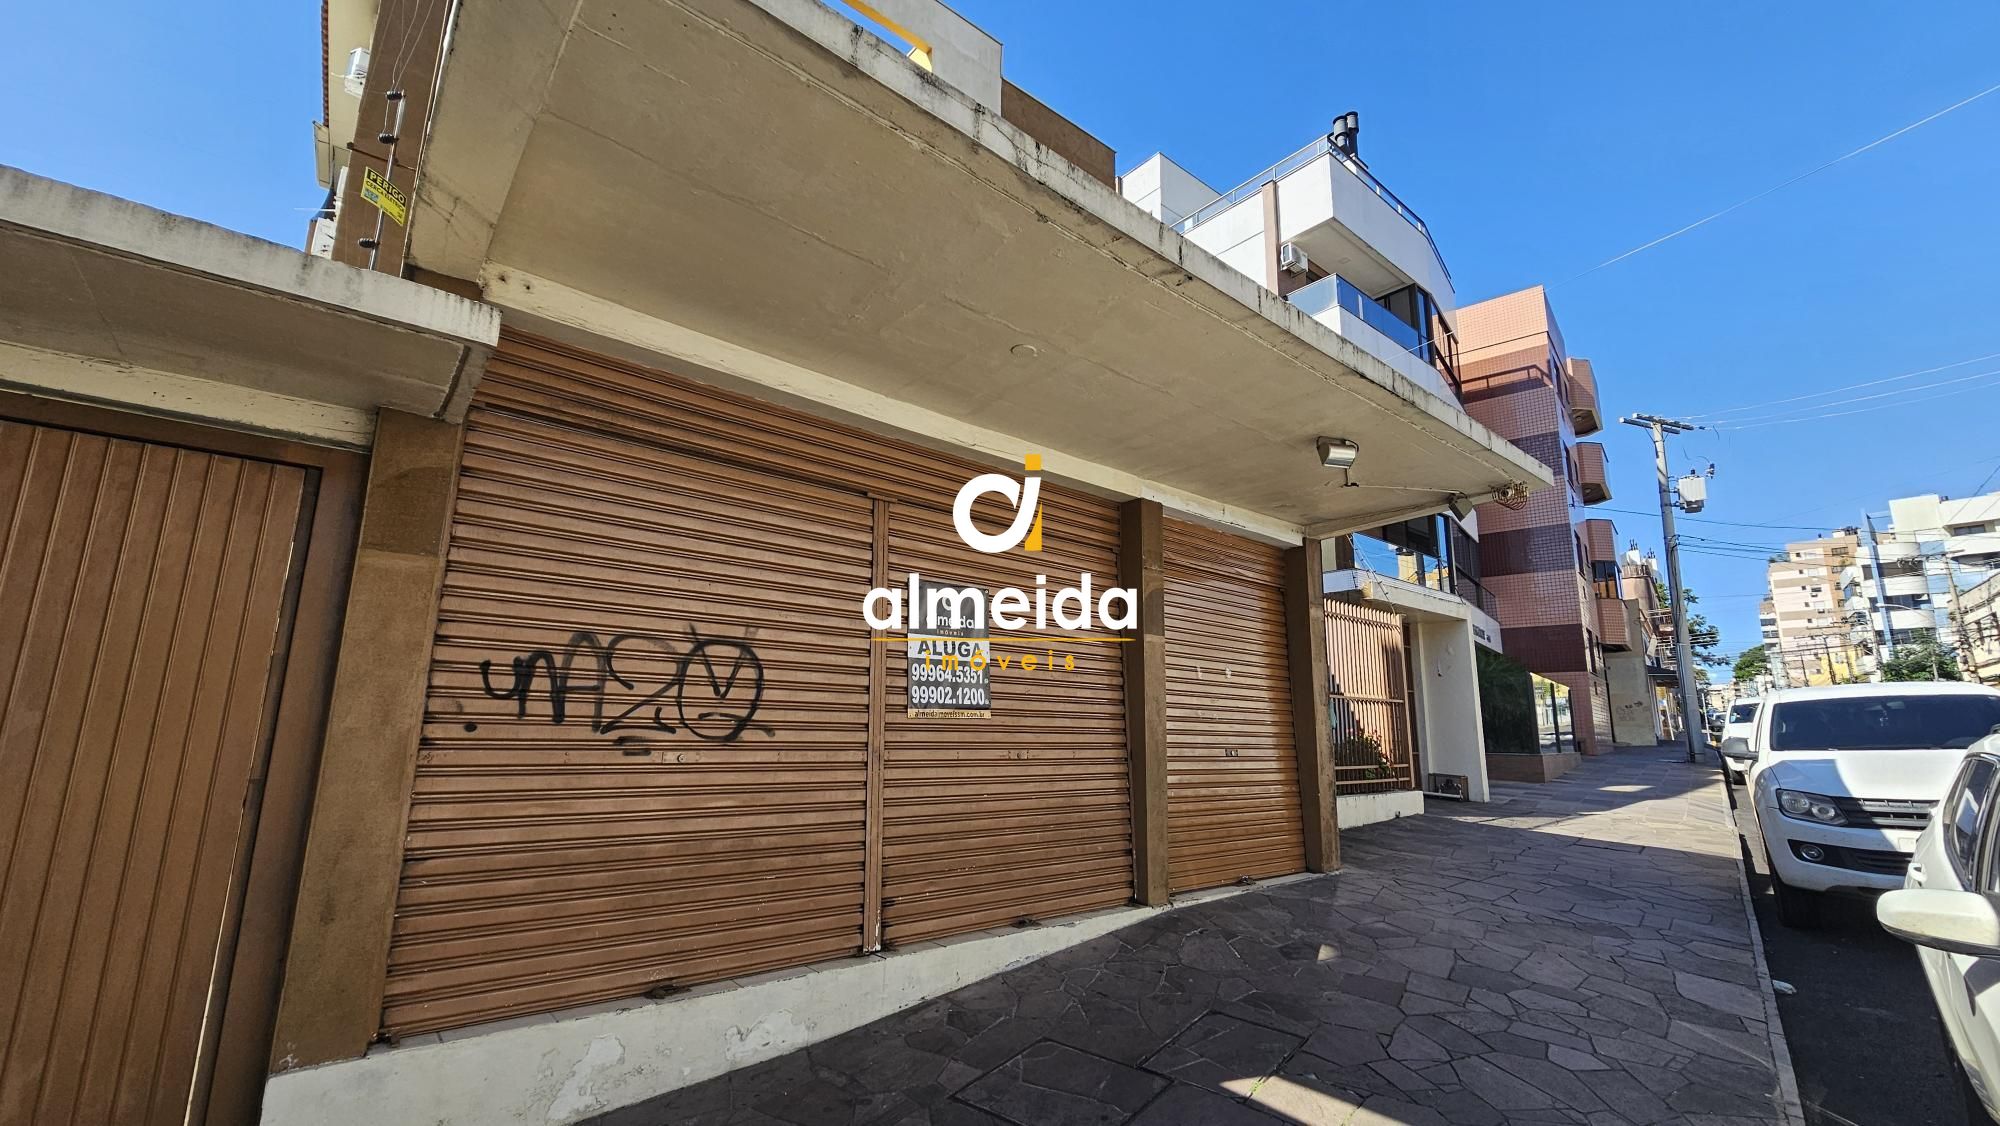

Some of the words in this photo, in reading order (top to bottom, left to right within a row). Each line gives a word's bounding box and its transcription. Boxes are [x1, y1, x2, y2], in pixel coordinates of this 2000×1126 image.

[369, 171, 405, 204] PERIGO
[917, 639, 983, 658] ALUGA
[911, 663, 983, 684] 99964.5351
[911, 685, 985, 705] 99902.1200
